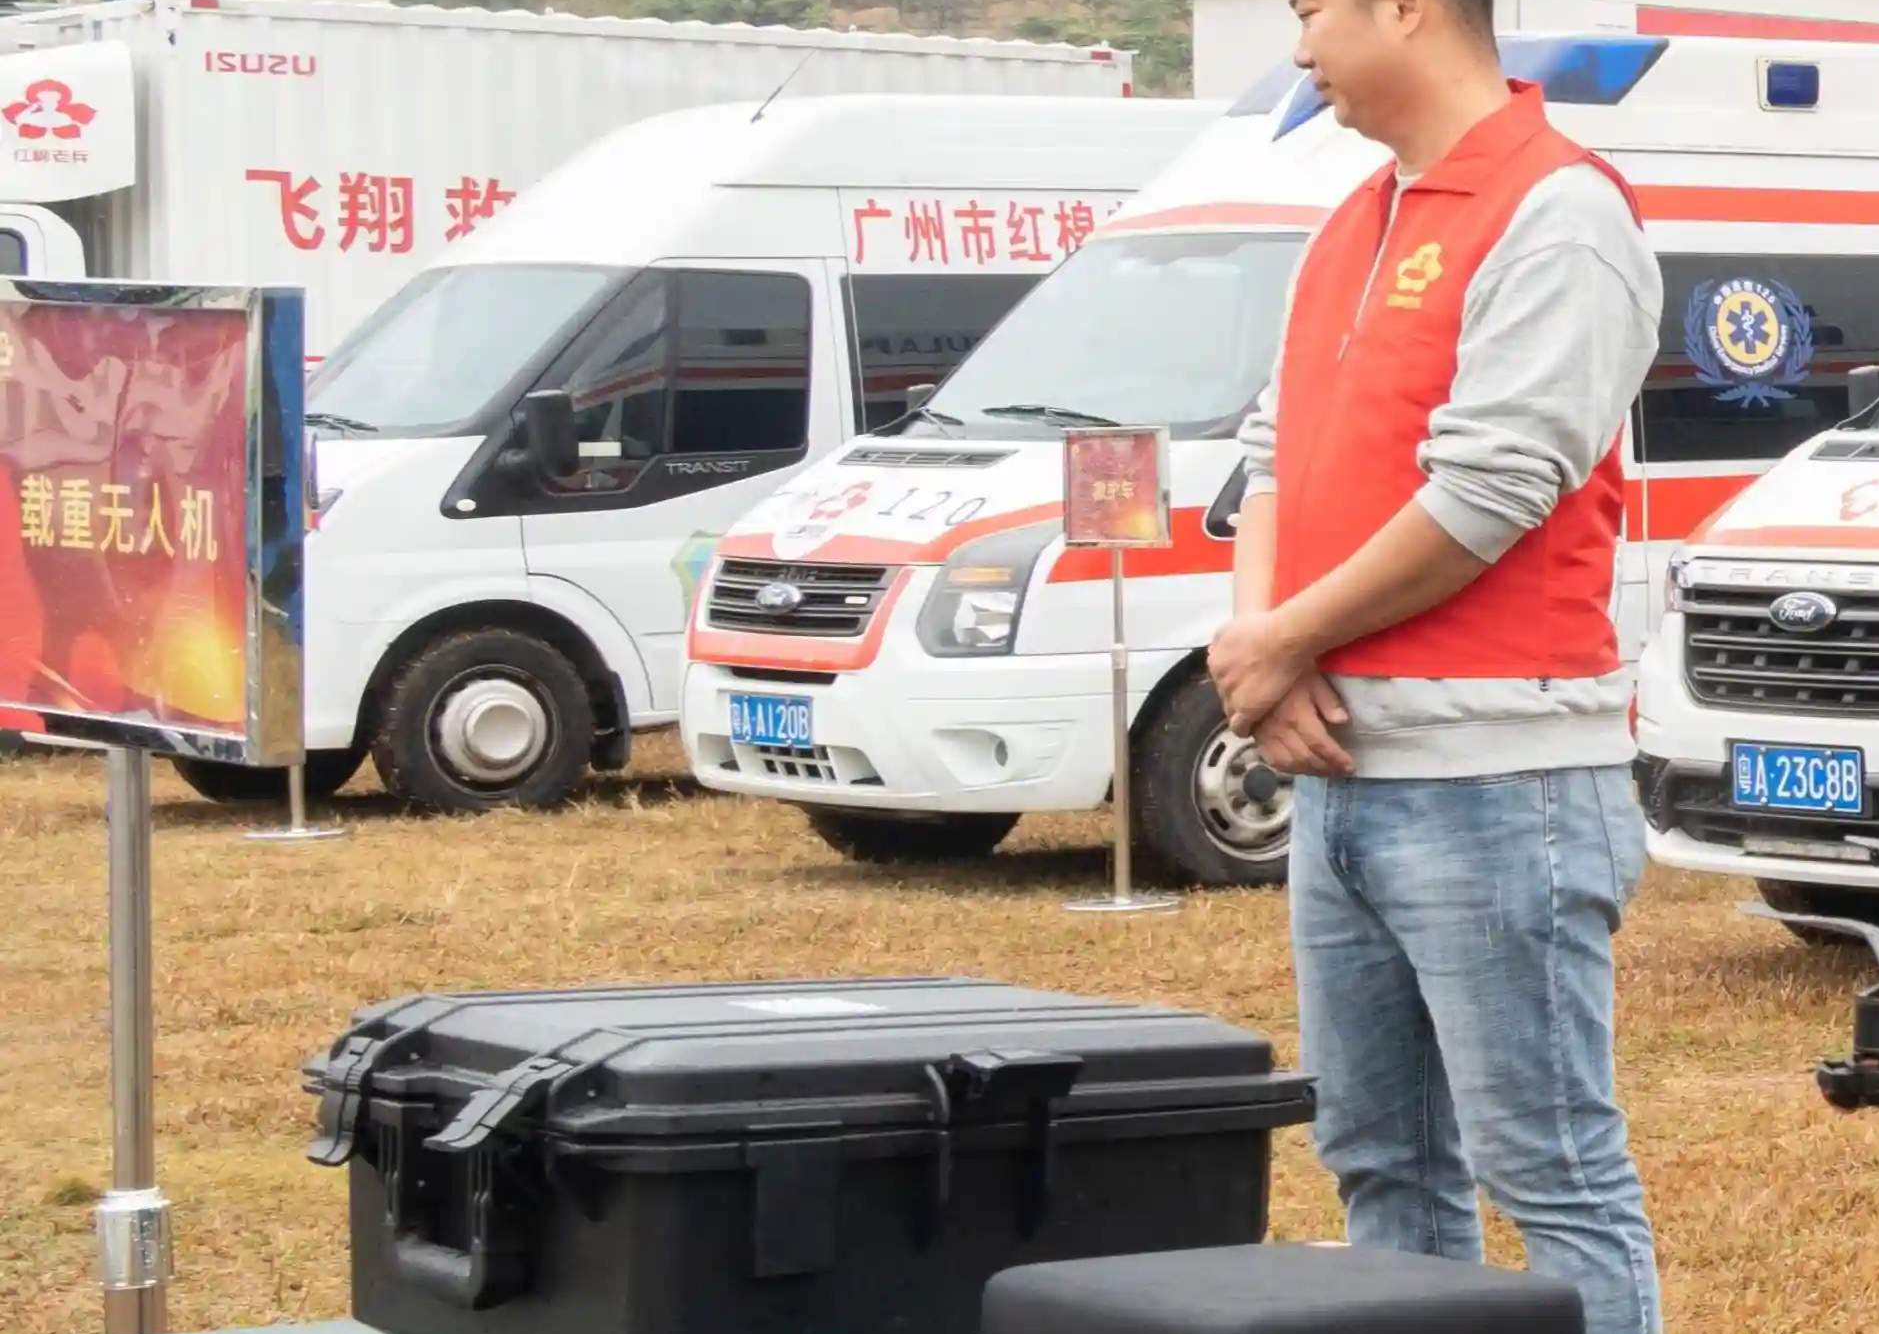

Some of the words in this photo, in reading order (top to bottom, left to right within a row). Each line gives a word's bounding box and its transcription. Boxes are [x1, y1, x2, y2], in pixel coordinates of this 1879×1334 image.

[853, 198, 1122, 265] 广州市红棉
[20, 473, 218, 562] 载重无人机
[1778, 597, 1817, 623] Ford
